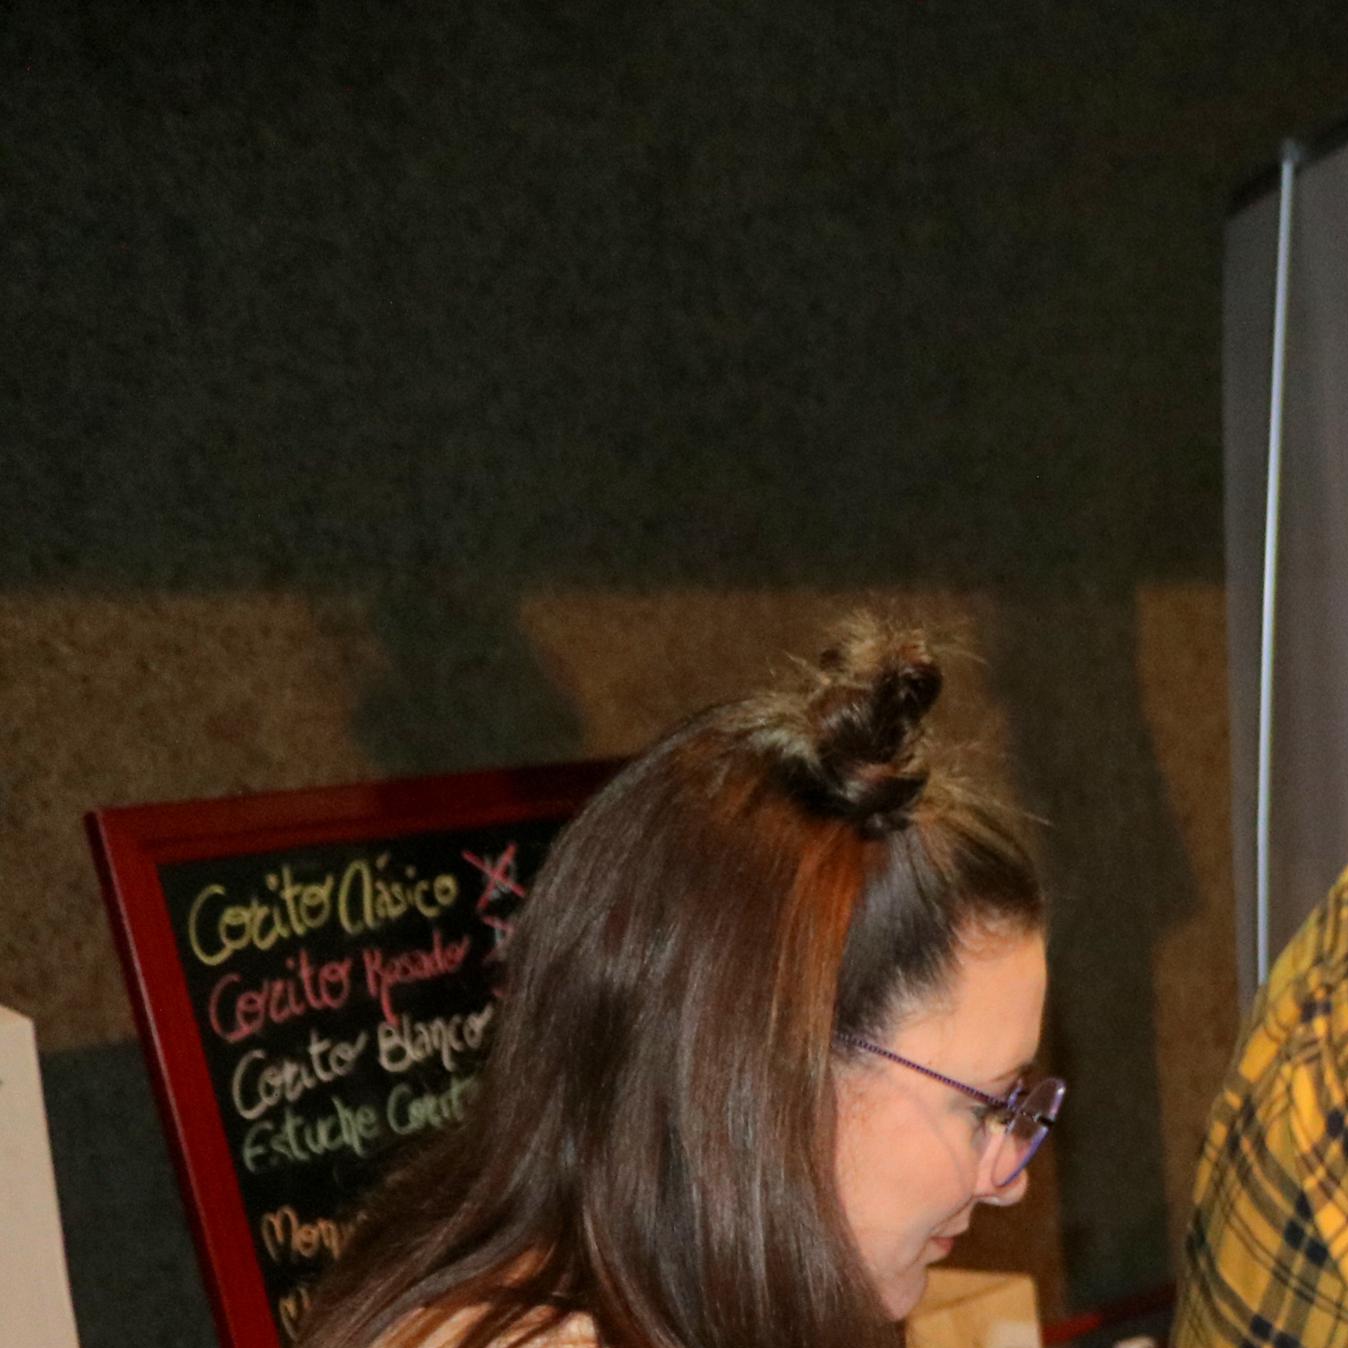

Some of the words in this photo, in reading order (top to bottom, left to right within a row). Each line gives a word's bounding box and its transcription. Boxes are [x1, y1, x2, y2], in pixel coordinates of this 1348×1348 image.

[188, 866, 334, 967] Corito
[208, 951, 353, 1043] Corito
[231, 1027, 367, 1120] Corito
[377, 1004, 494, 1073] Blanco
[242, 1090, 380, 1175] Estuche
